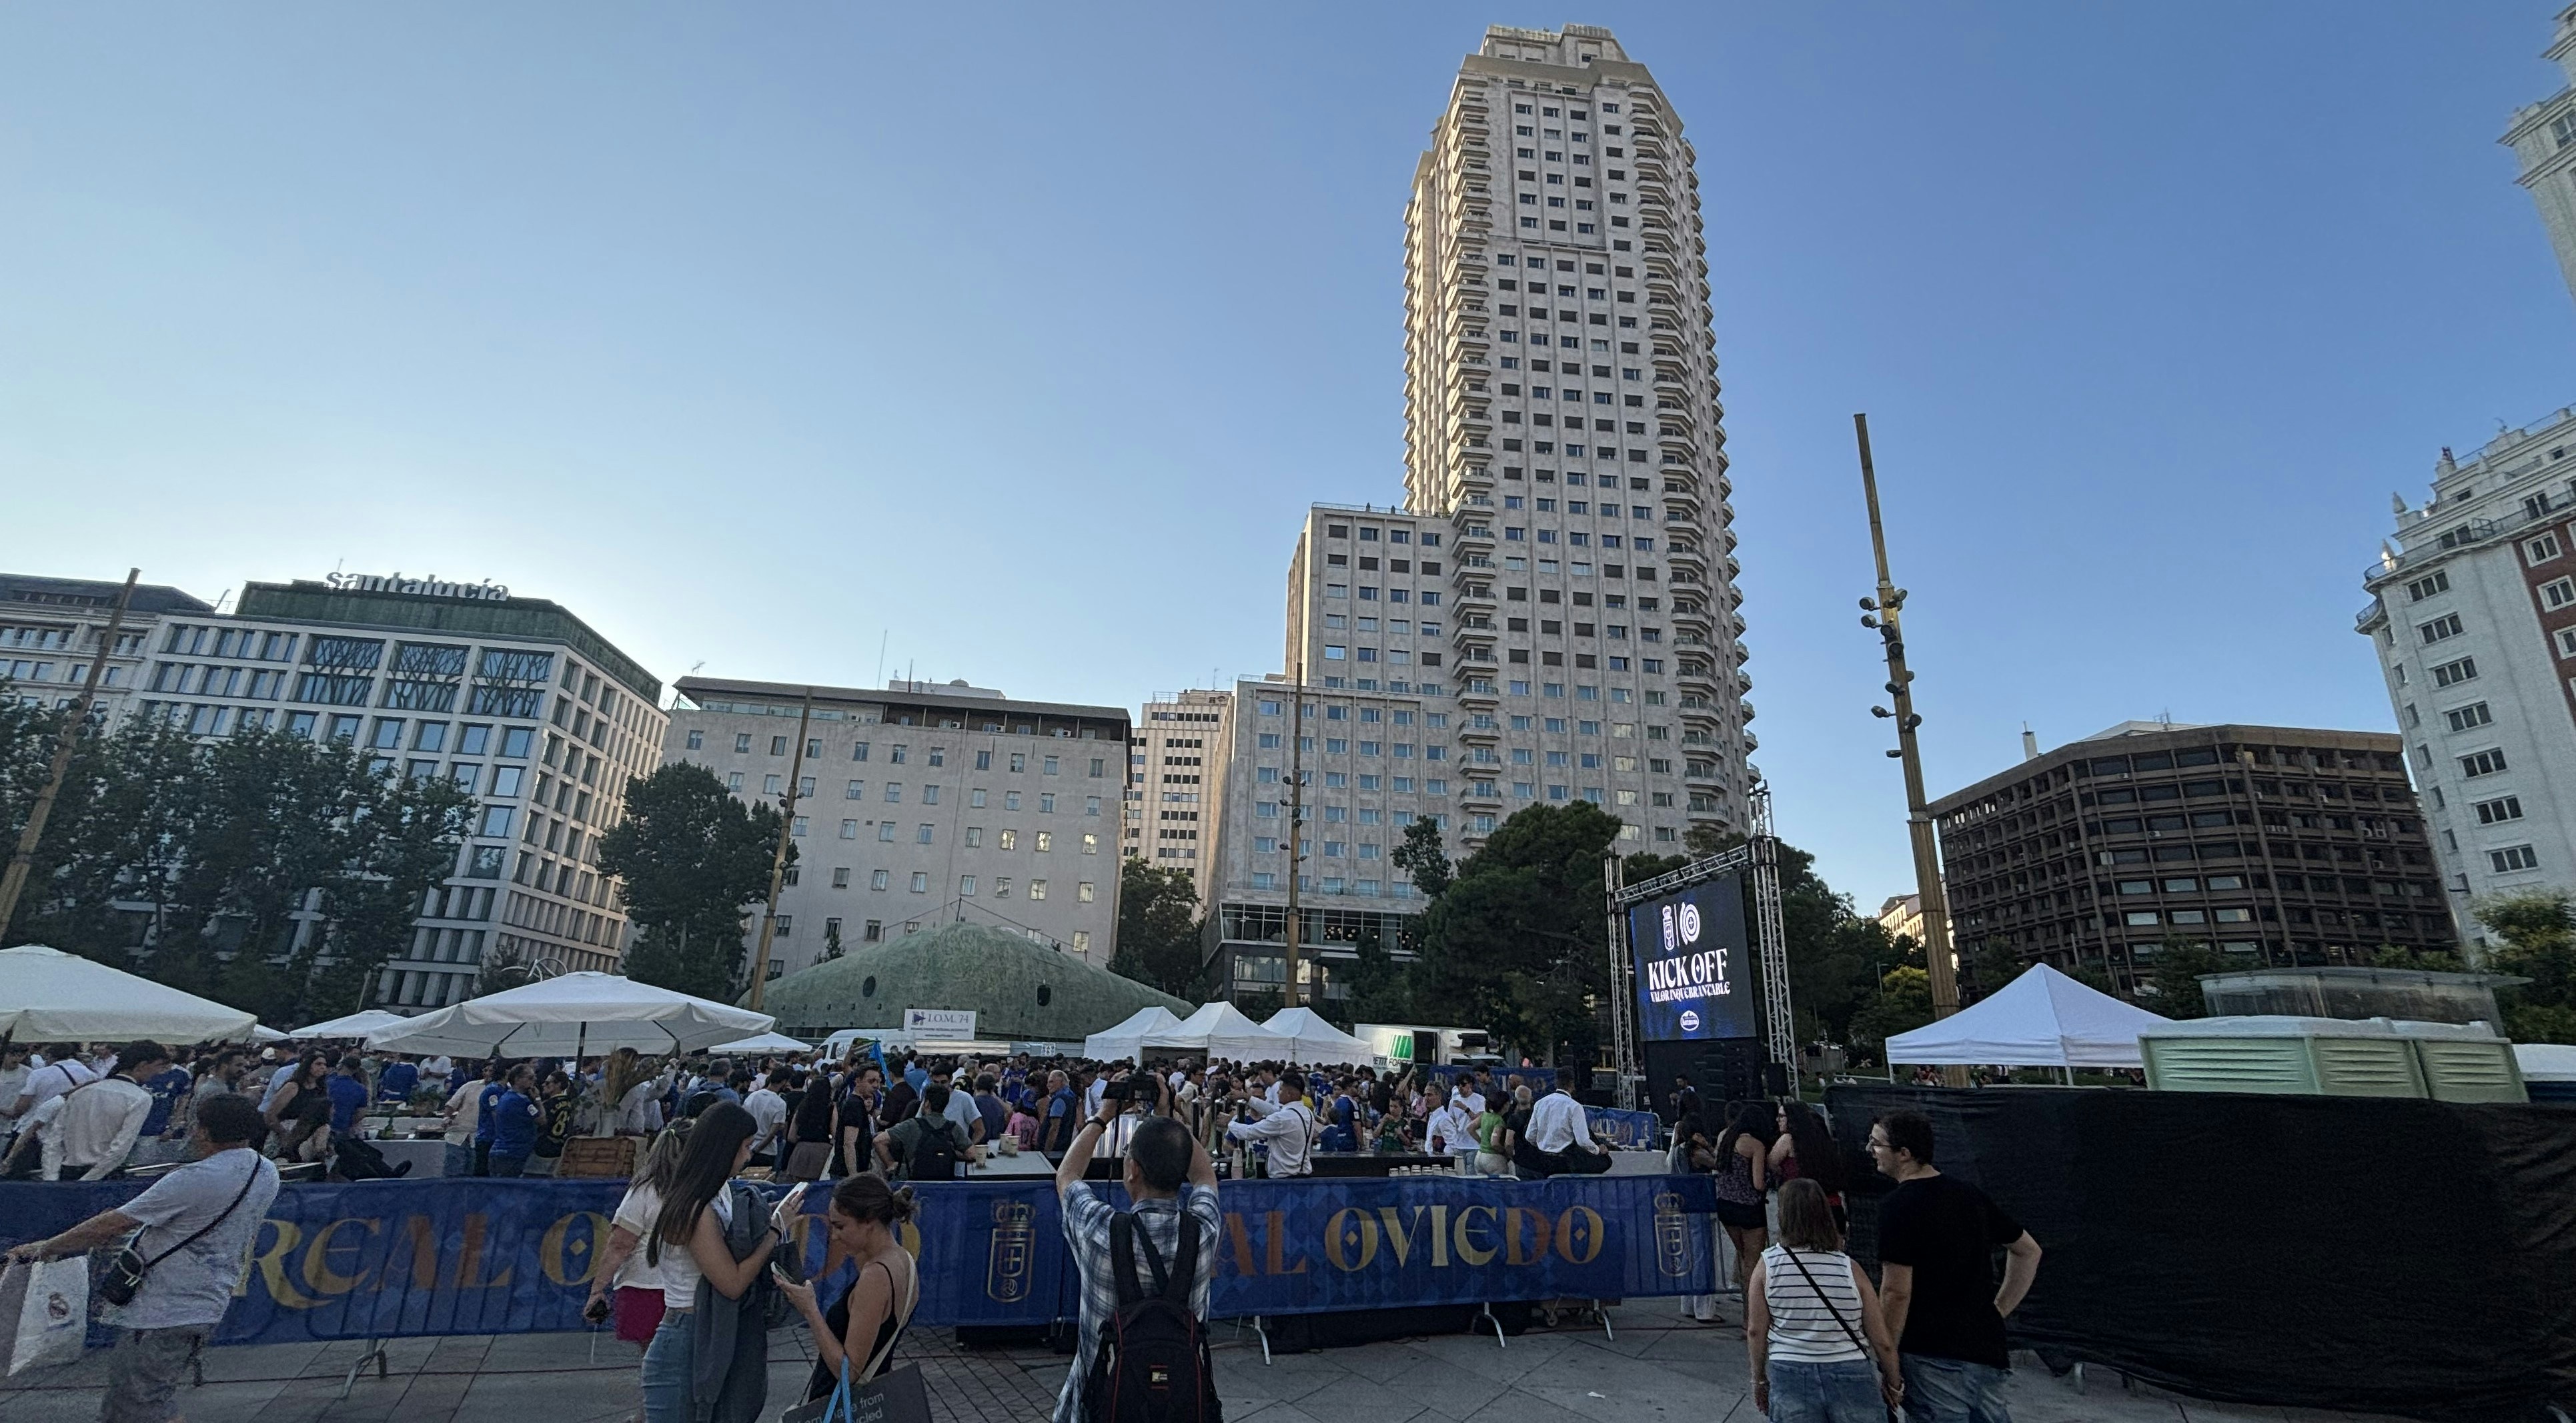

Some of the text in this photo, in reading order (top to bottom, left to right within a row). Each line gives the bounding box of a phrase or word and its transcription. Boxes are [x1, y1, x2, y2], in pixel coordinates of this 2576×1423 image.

[326, 571, 509, 601] santalucía
[1648, 948, 1728, 990] KICK OFF
[1650, 990, 1670, 1003] VALOR
[958, 1014, 969, 1024] 74
[1211, 1205, 1604, 1277] AL OVIEDO
[231, 1214, 512, 1309] REAL
[860, 1392, 884, 1409] from
